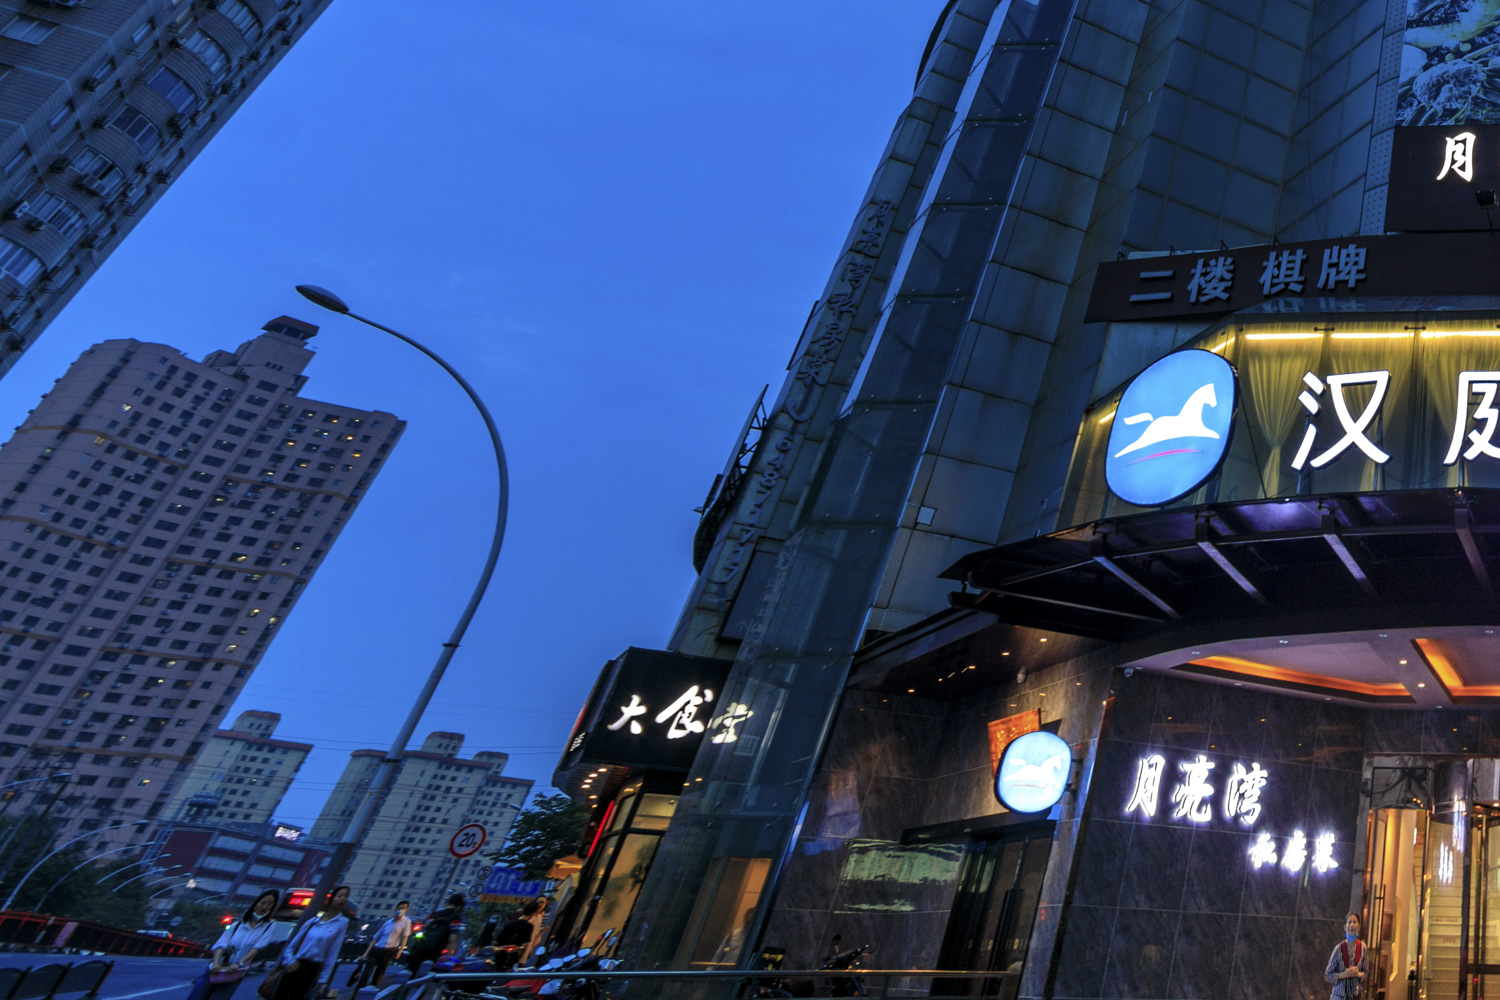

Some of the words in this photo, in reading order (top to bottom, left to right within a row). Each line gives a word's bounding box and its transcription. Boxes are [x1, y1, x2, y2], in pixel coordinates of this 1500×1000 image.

[1129, 256, 1235, 304] 二楼
[1258, 243, 1367, 296] 棋牌
[606, 684, 755, 745] 大食堂
[1124, 754, 1269, 825] 月亮湾
